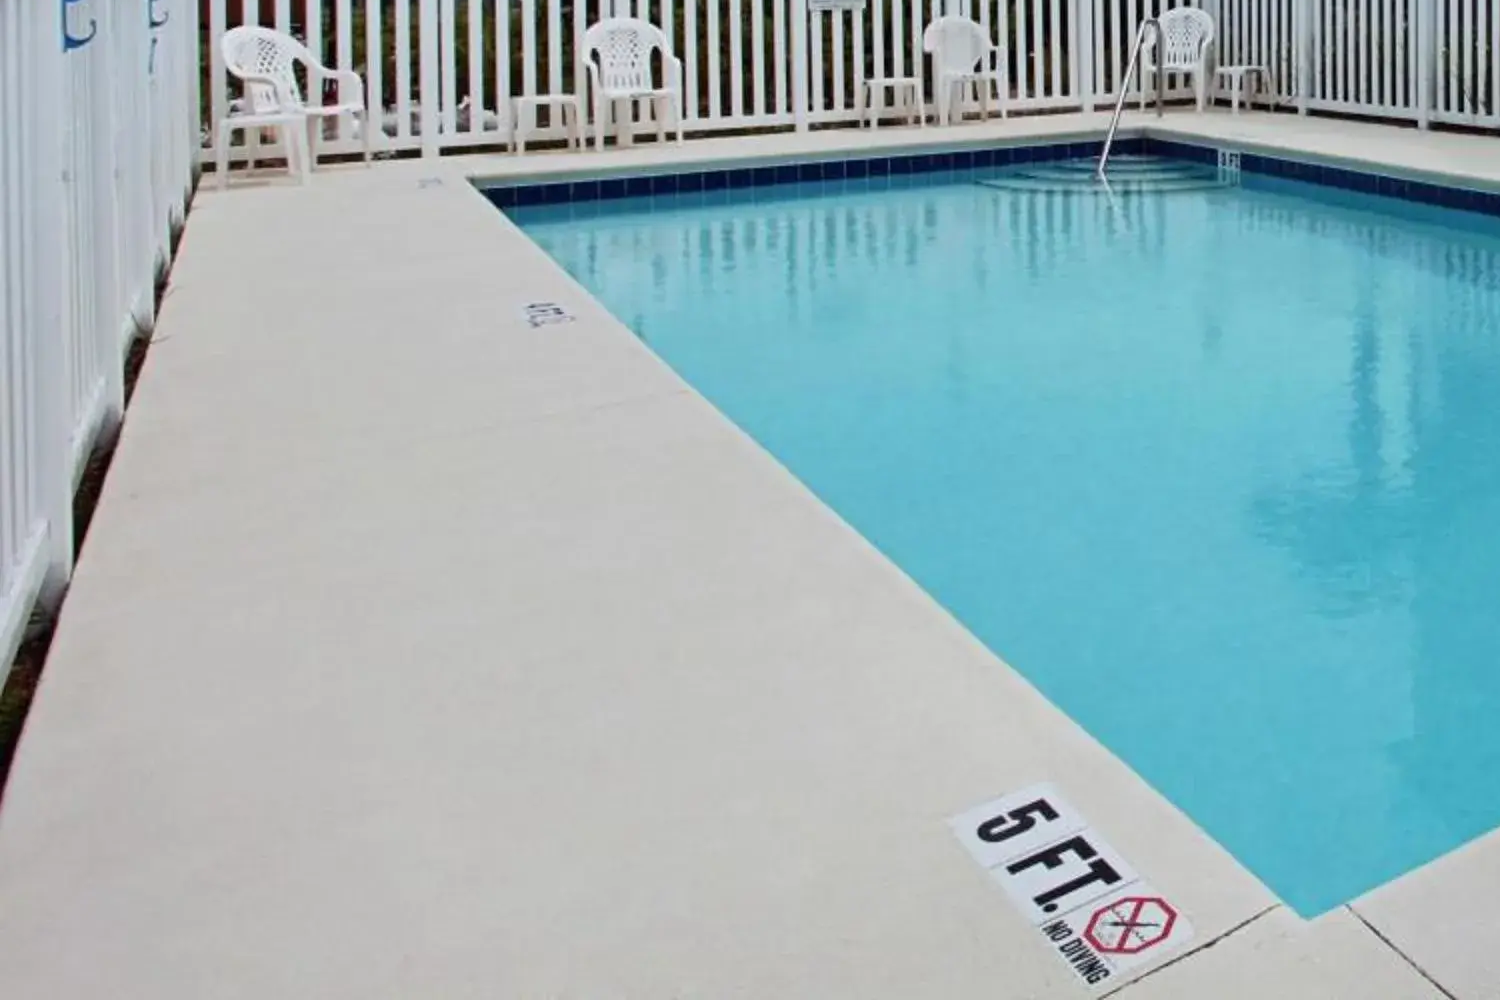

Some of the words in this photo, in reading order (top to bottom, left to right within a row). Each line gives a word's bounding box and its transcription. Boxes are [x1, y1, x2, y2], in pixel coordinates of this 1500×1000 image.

[976, 797, 1061, 843] 5
[1005, 835, 1123, 914] FT.
[1041, 919, 1074, 942] NO
[1058, 937, 1111, 985] DIVING
